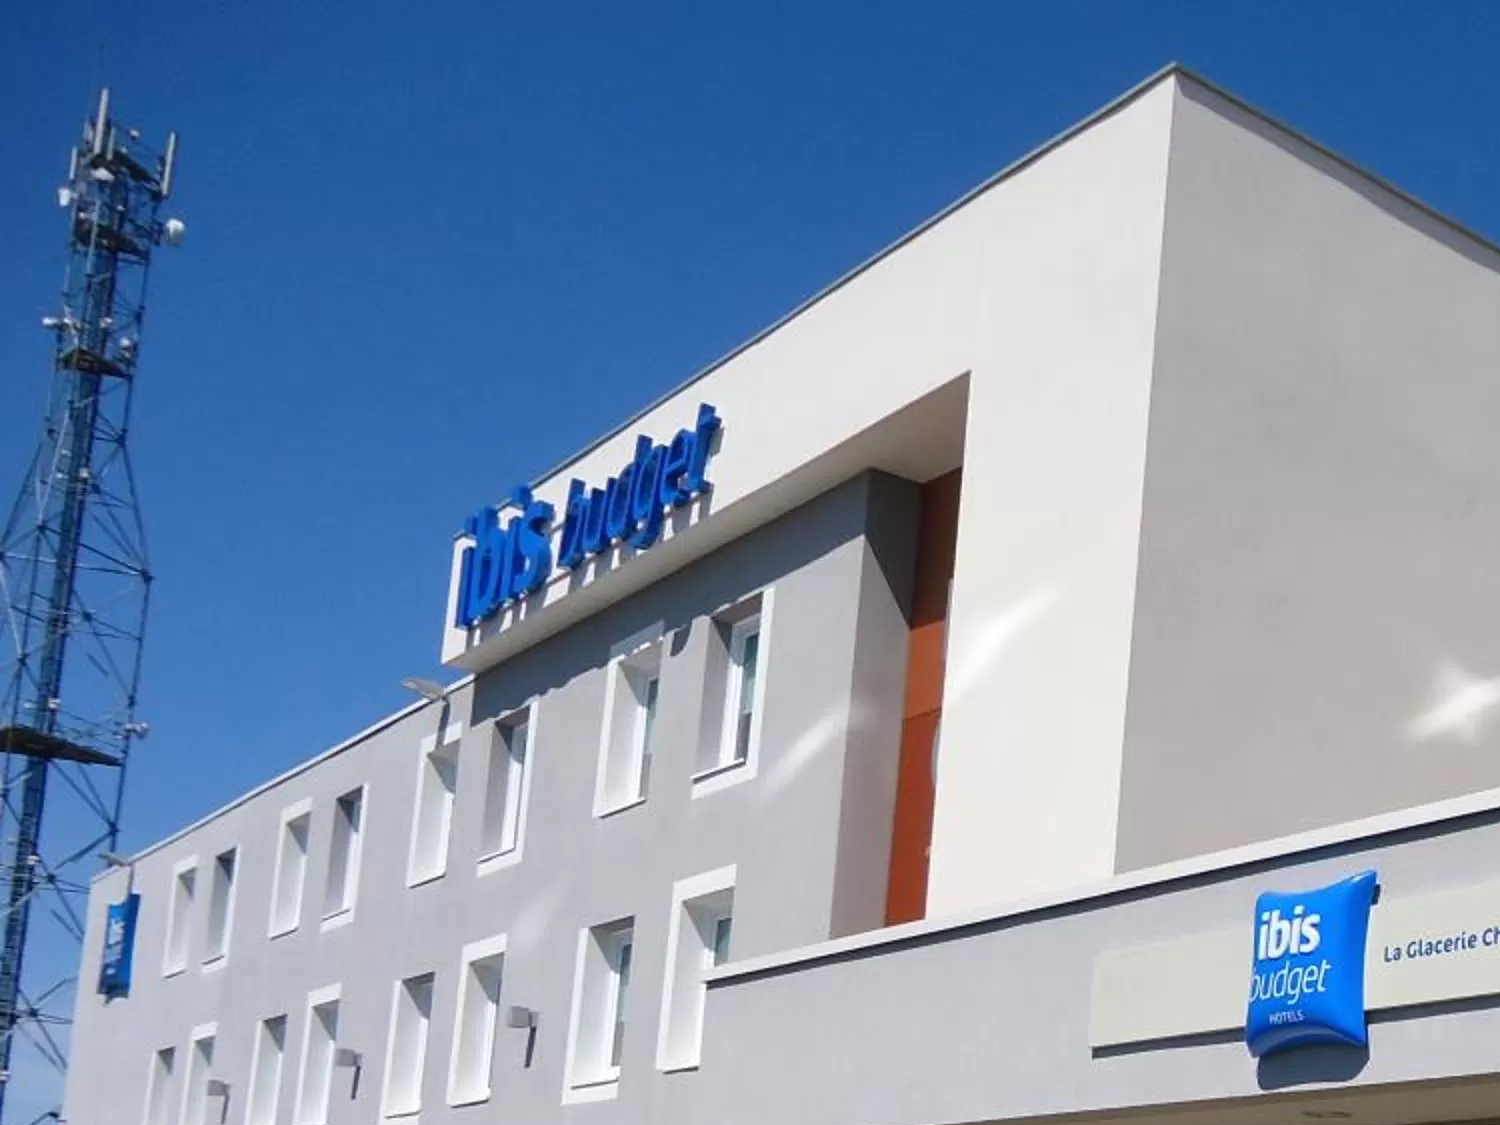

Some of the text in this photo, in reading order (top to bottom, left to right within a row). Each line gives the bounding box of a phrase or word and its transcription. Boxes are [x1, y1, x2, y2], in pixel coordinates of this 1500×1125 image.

[456, 403, 721, 629] ibis budget
[1258, 904, 1322, 961] ibis
[1383, 945, 1402, 963] La
[1406, 931, 1478, 959] Glacerie
[1268, 1008, 1305, 1025] HOTELS
